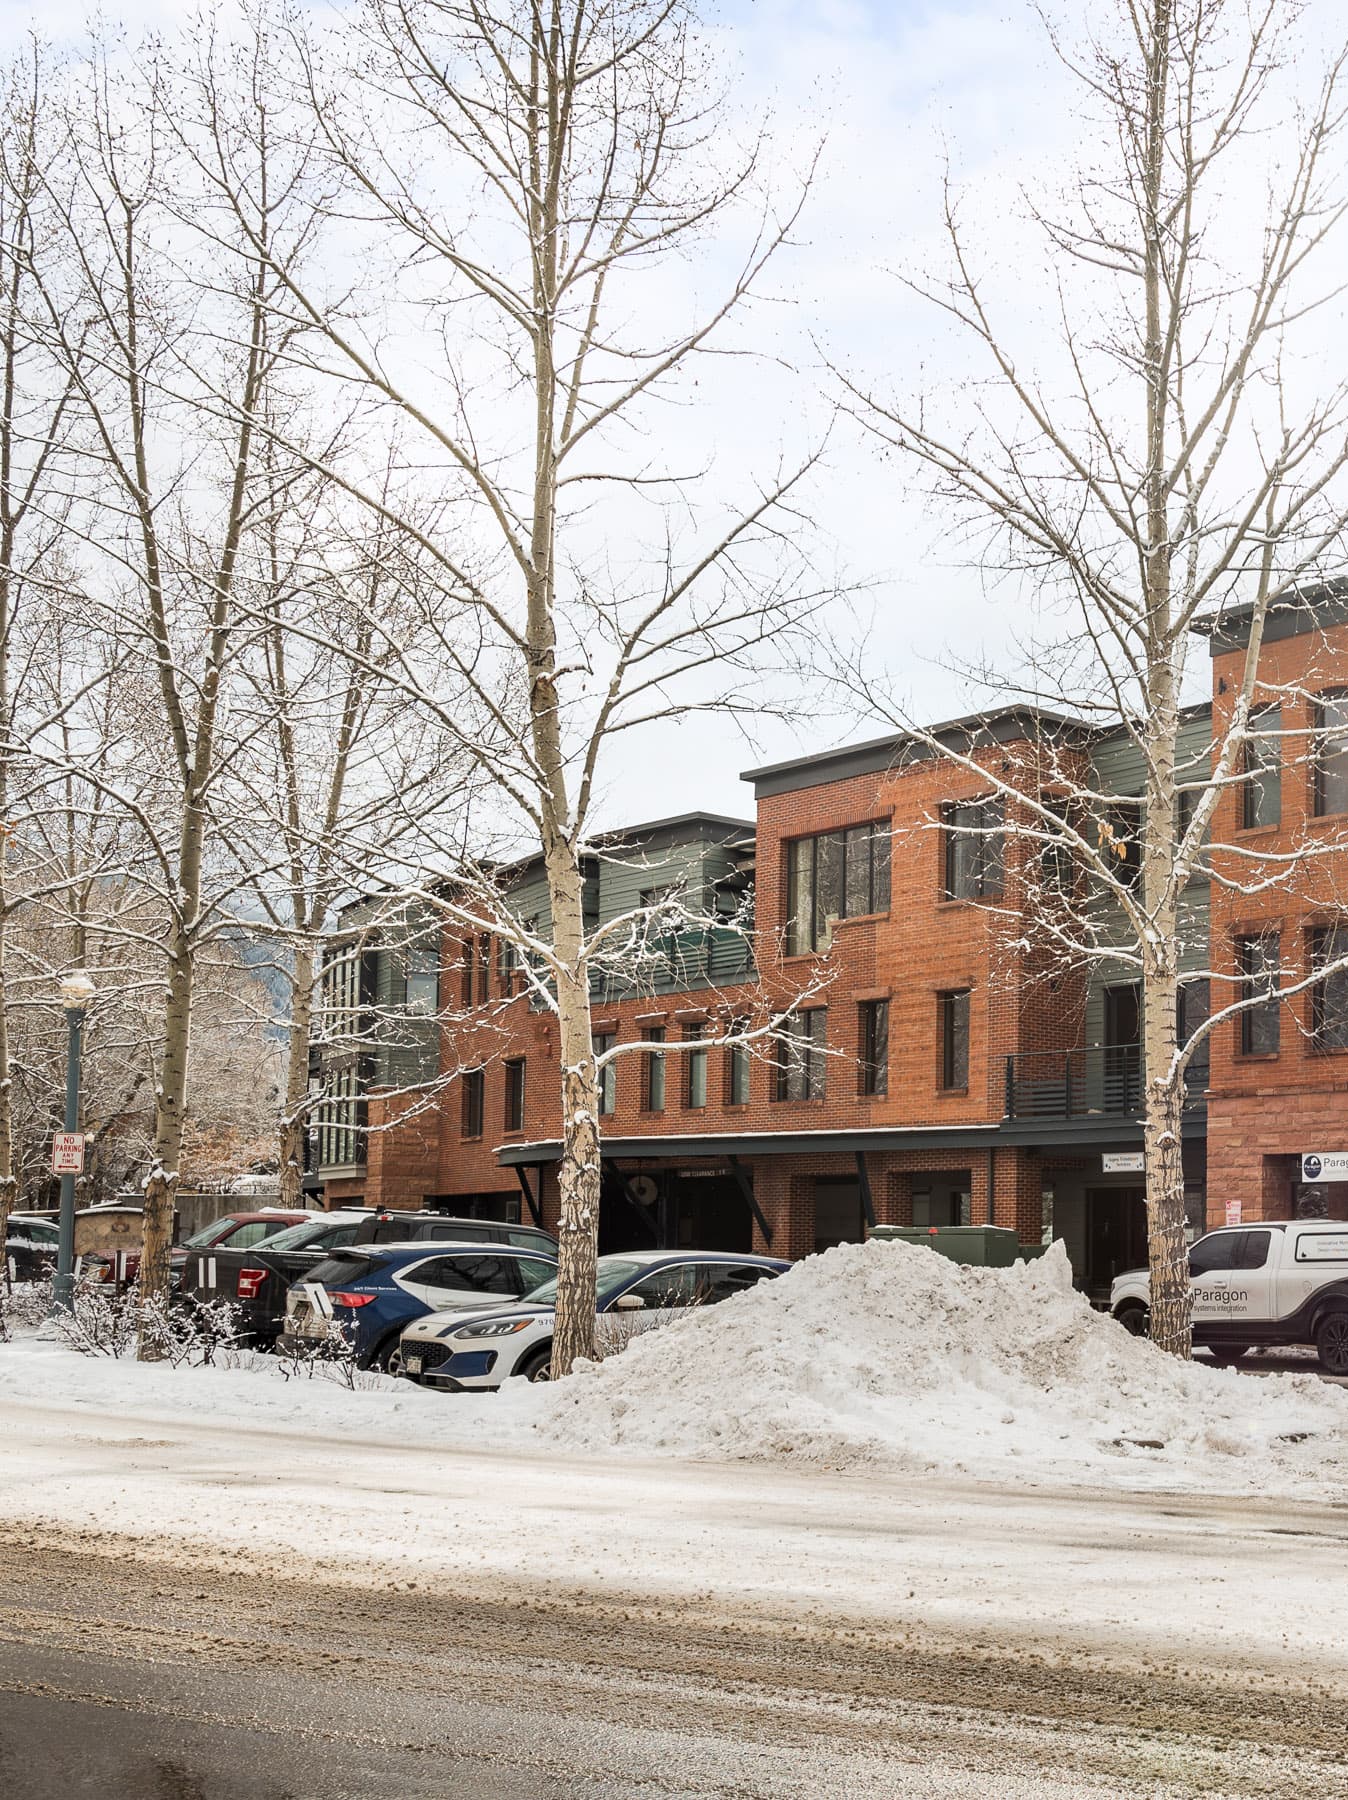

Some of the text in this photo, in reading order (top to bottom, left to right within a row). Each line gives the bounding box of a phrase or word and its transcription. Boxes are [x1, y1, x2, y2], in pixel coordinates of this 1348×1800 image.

[63, 1136, 75, 1145] NO
[55, 1145, 82, 1153] PARKING
[1194, 1287, 1248, 1304] Paragon
